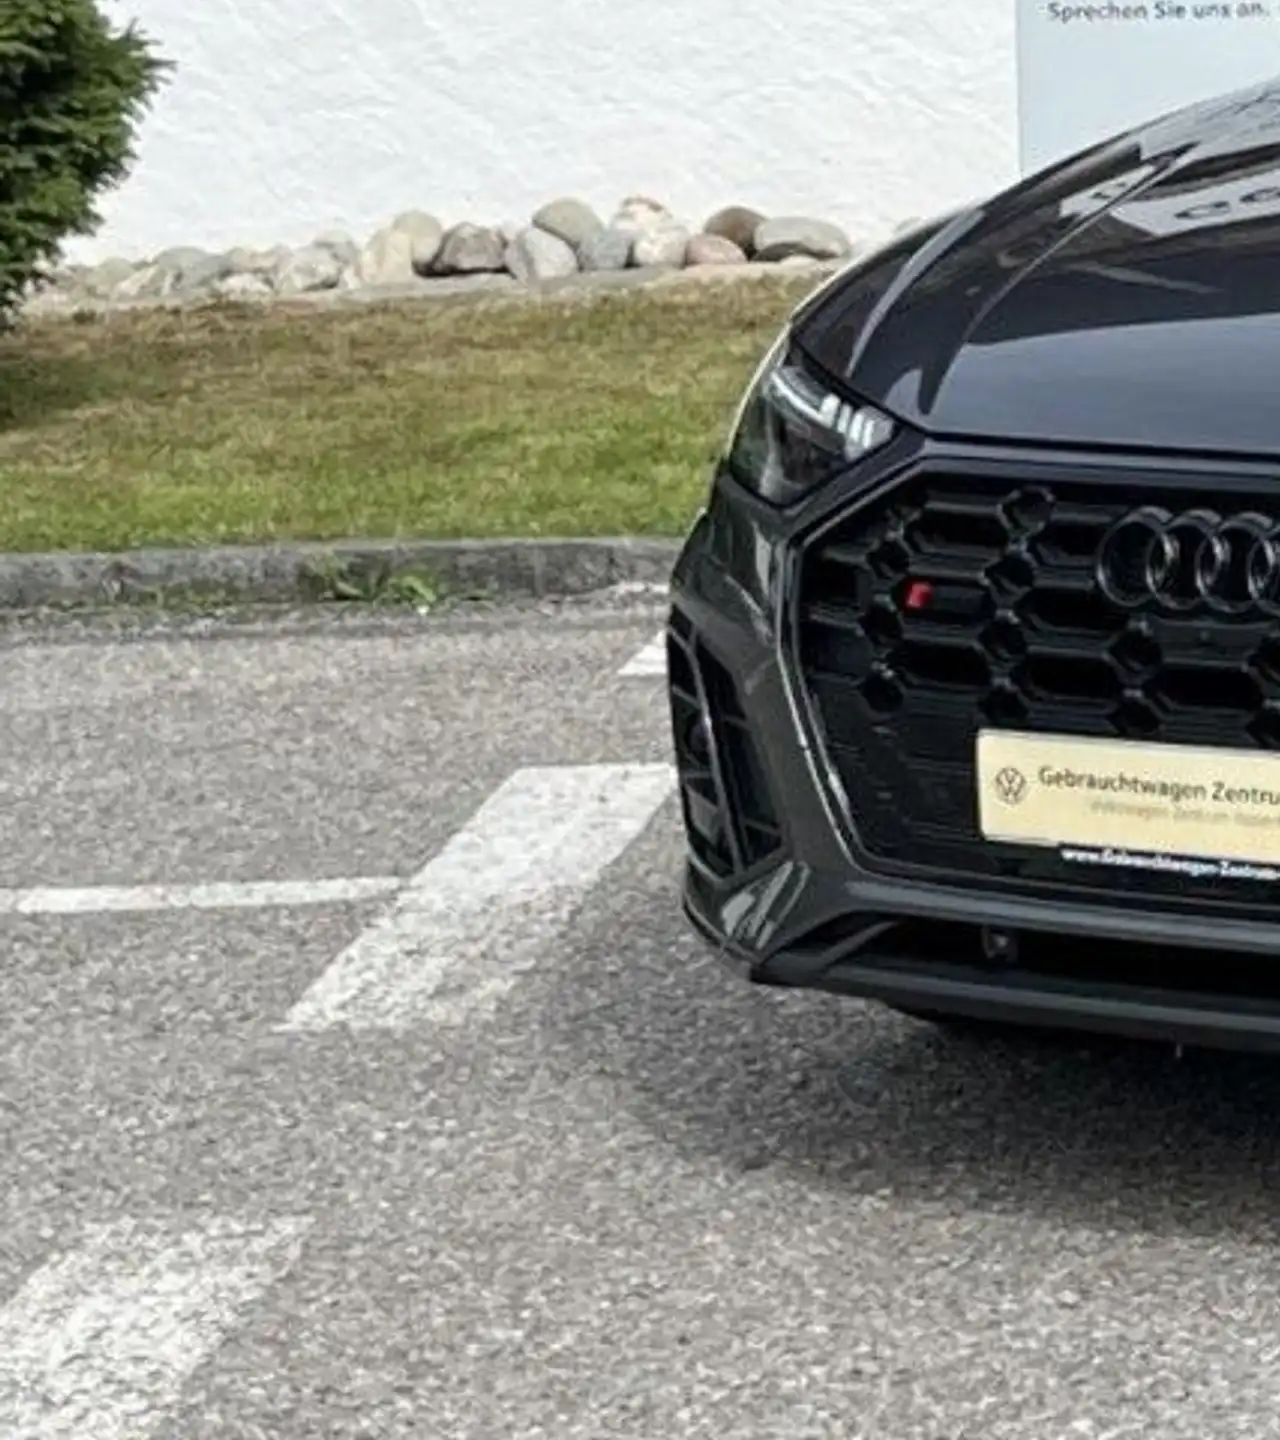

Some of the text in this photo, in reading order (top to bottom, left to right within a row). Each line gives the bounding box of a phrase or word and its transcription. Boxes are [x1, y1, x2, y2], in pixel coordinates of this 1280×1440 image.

[1046, 0, 1149, 24] Sprechen
[1153, 0, 1187, 20] Sie
[1038, 765, 1207, 802] Gebrauchtwagen
